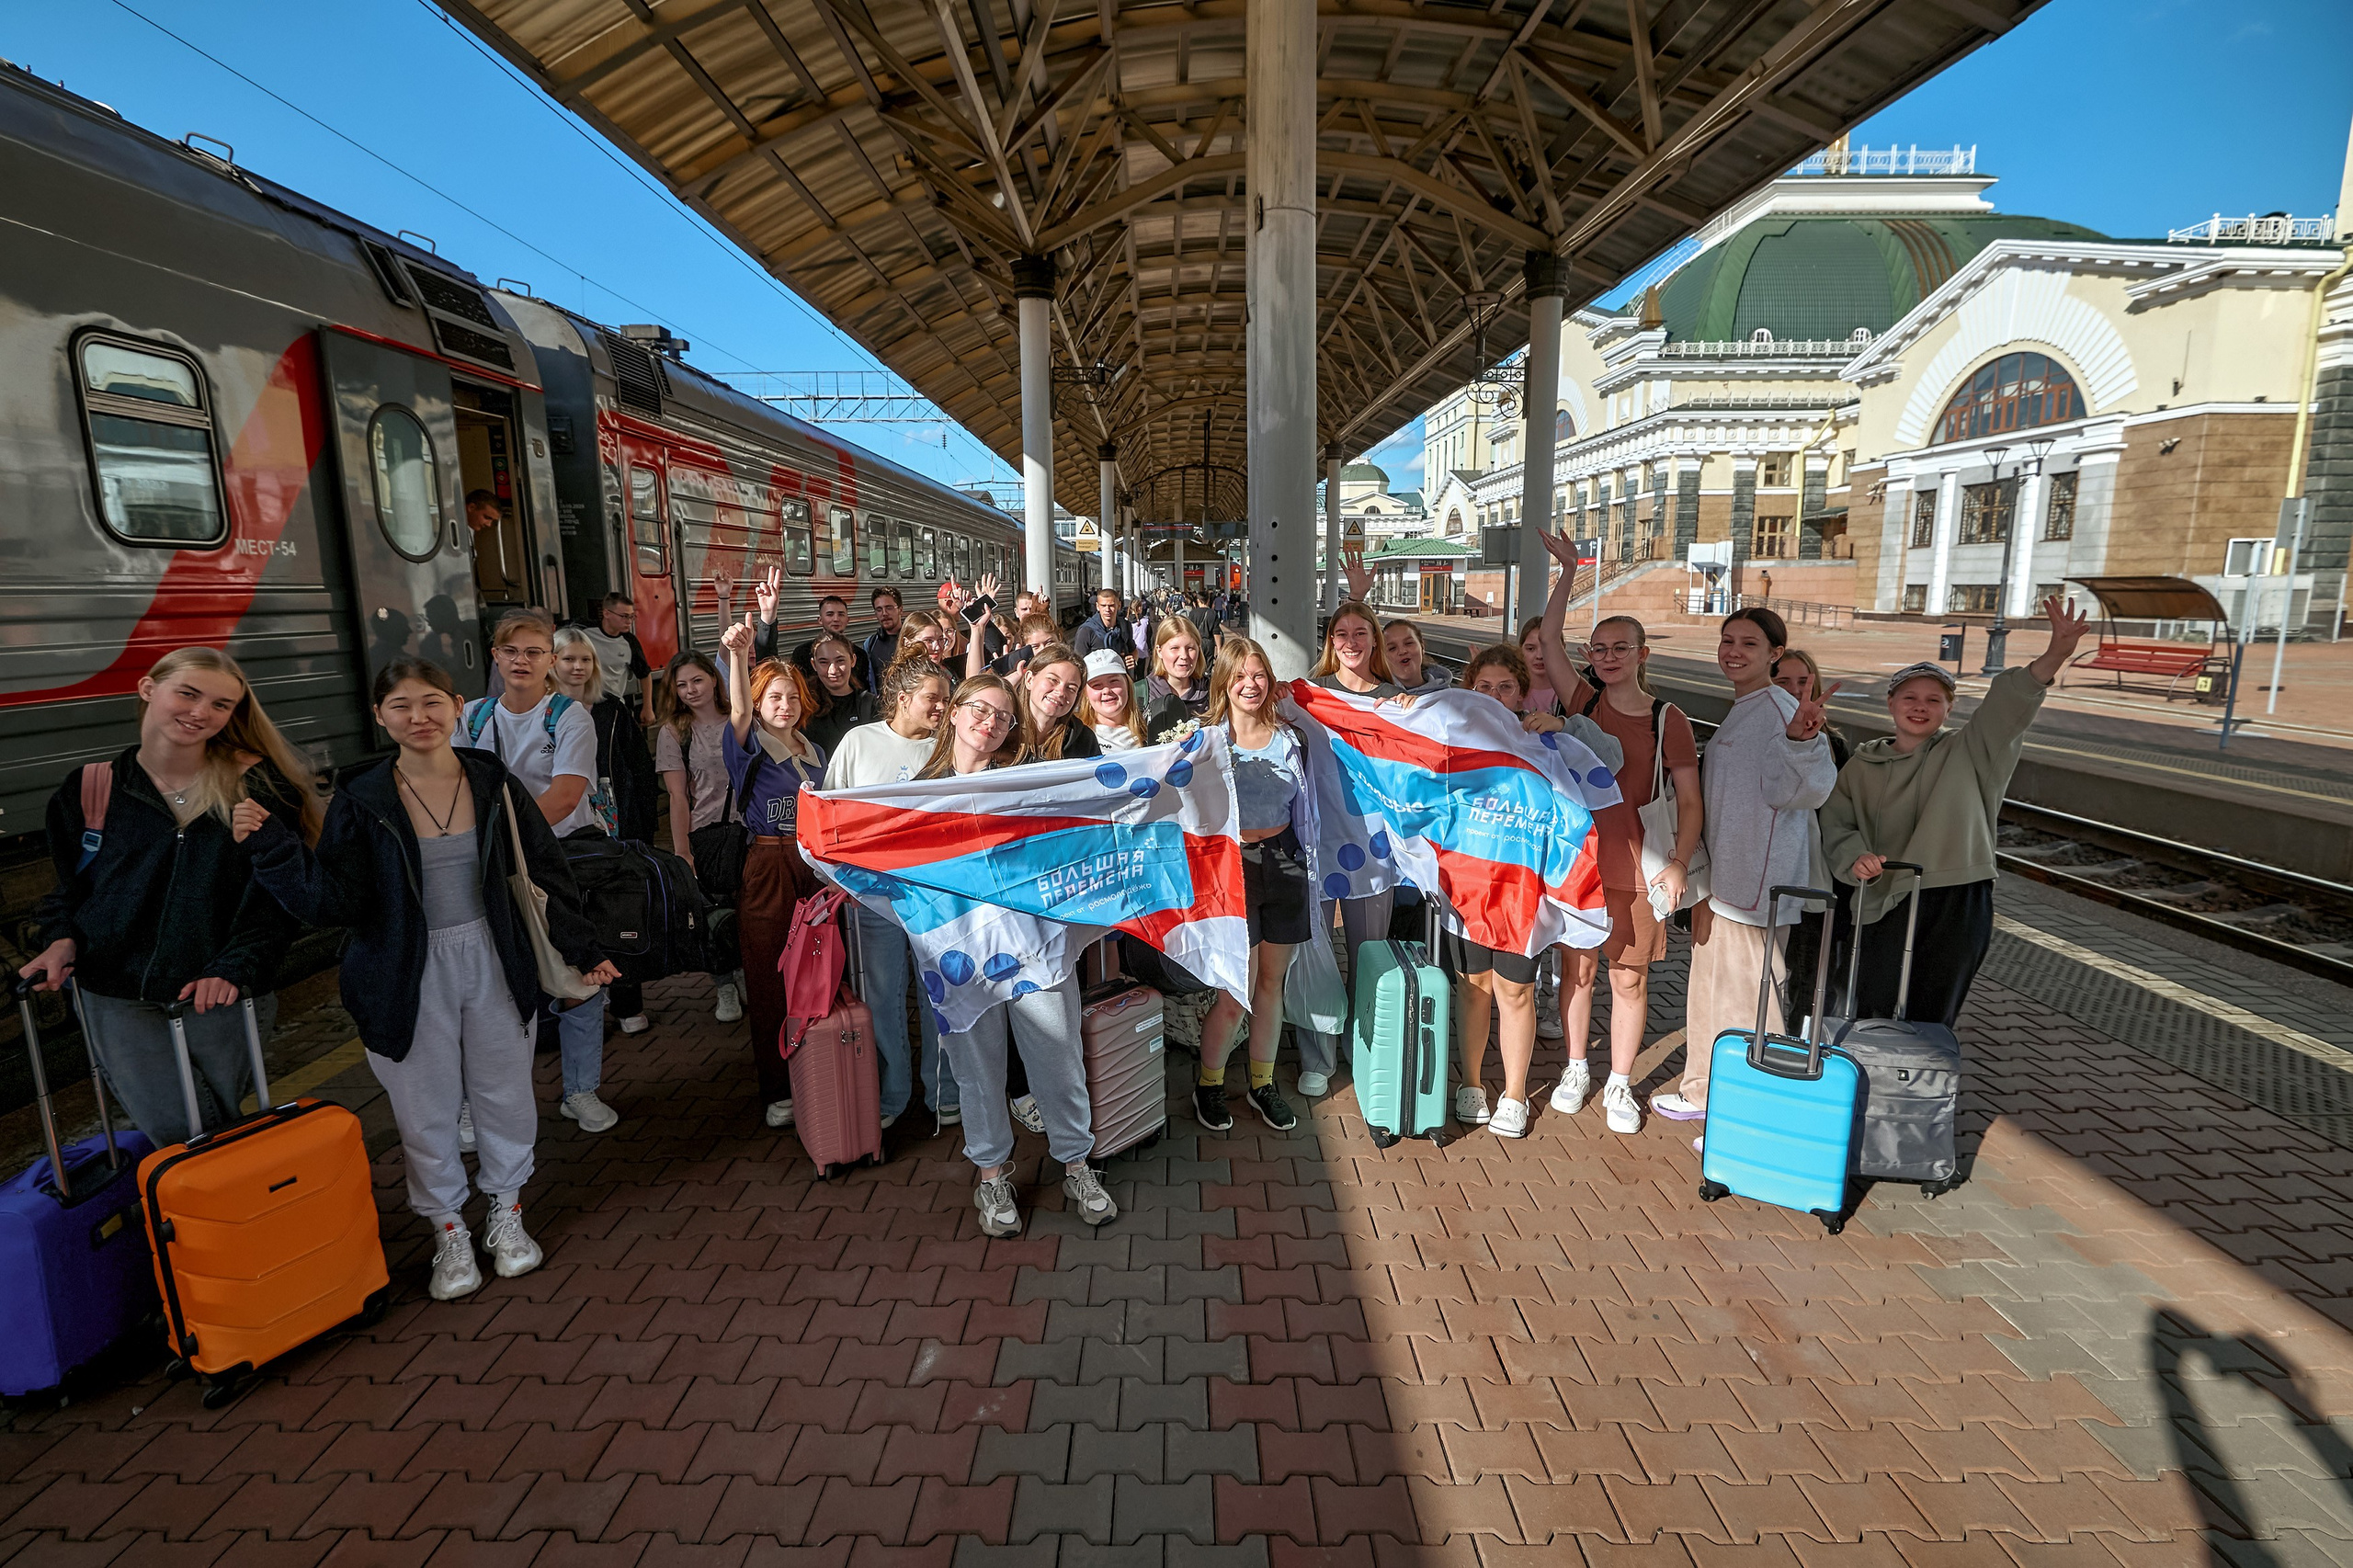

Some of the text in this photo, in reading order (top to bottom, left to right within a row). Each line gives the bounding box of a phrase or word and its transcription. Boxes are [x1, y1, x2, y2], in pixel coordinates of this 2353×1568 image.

[234, 539, 297, 556] МЕСТ-54
[767, 796, 796, 823] DR
[1037, 850, 1144, 892] БОЛЬШАЯ
[1040, 864, 1143, 909] ПЕРЕМЕНА
